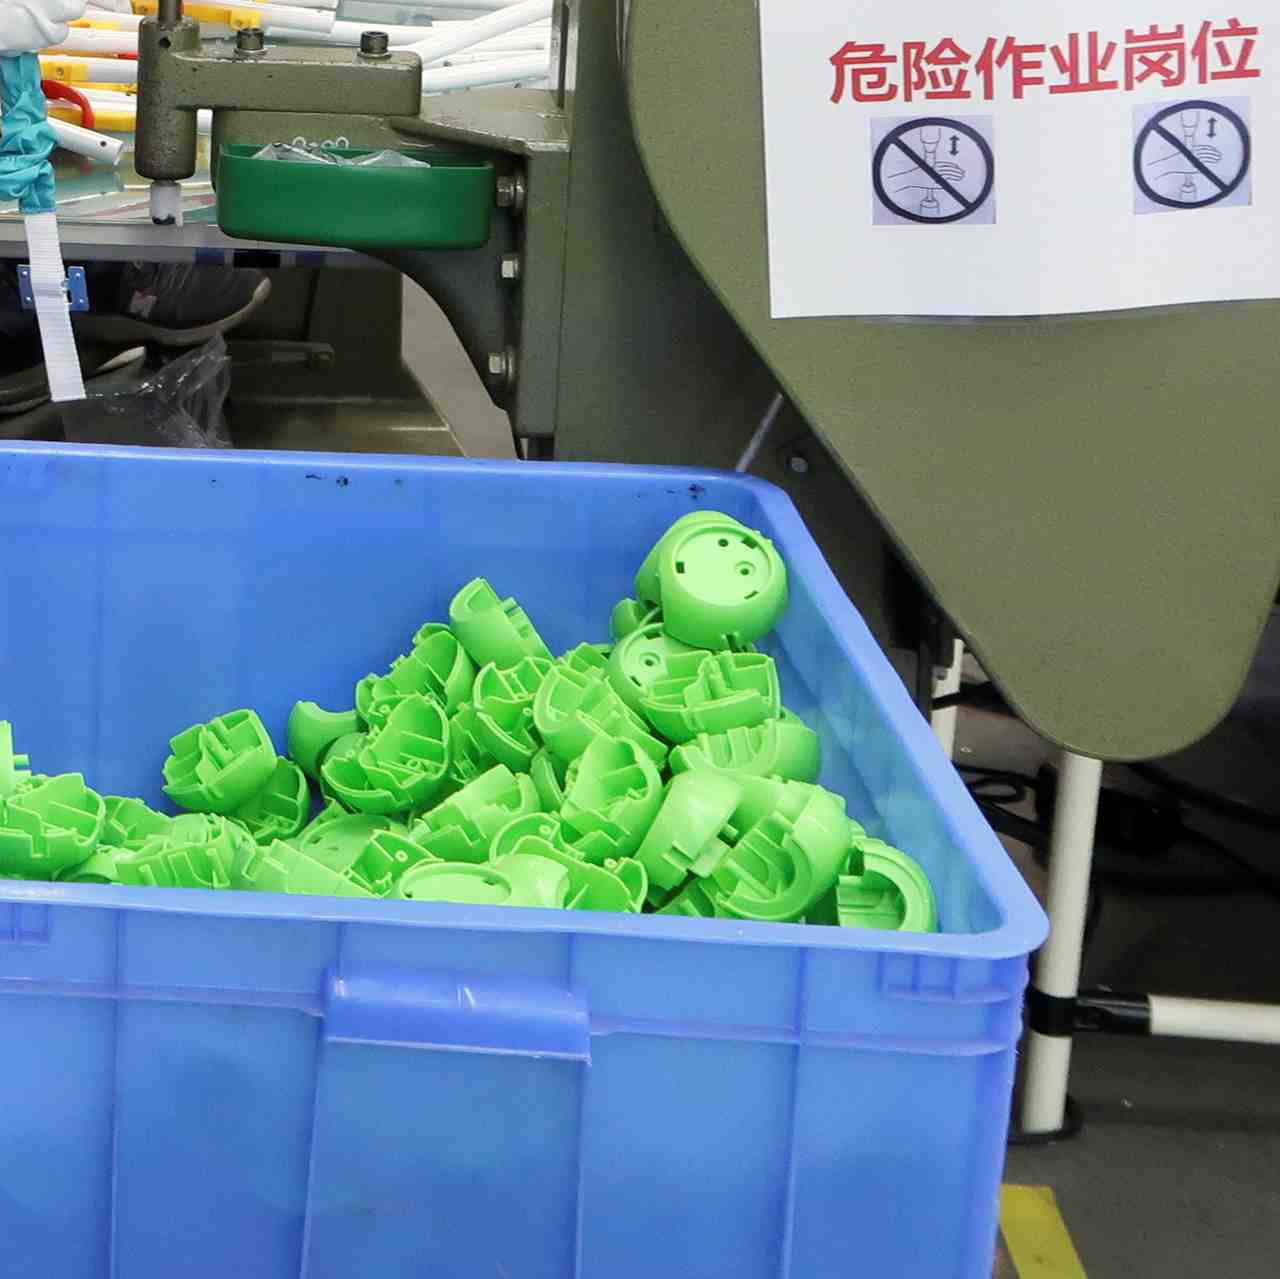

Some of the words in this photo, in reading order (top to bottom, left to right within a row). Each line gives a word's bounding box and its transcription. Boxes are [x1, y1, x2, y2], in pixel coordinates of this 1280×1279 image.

[829, 17, 1261, 104] 危险作业岗位
